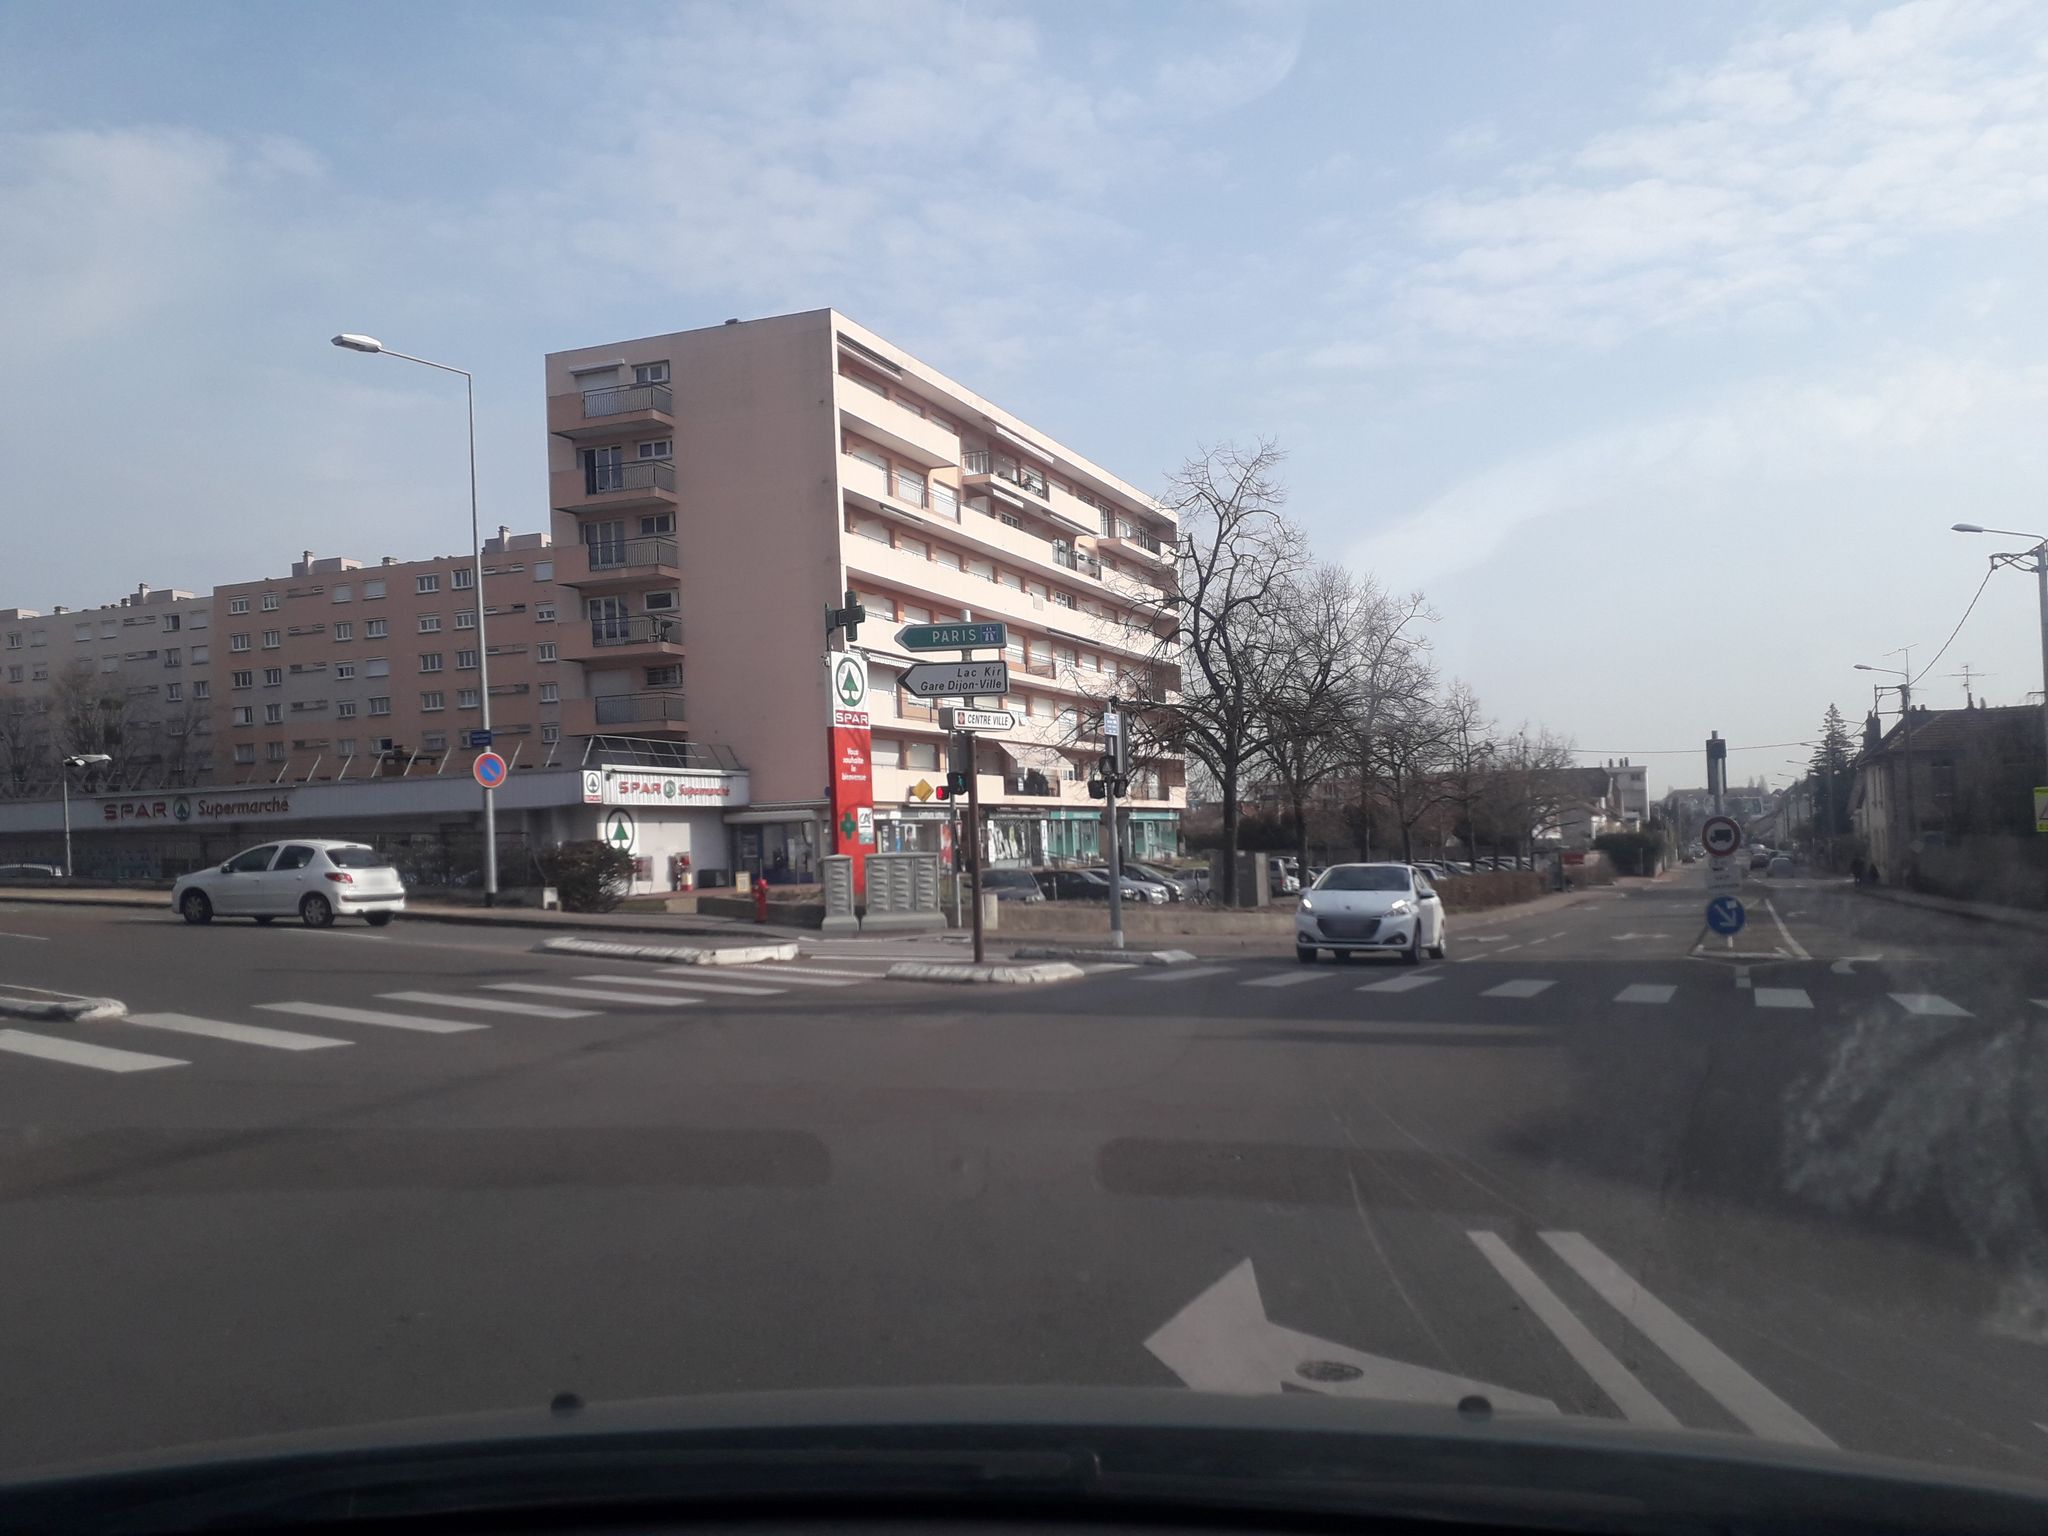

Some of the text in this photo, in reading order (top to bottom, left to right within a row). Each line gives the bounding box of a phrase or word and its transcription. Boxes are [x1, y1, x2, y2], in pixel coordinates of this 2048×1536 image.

[932, 629, 977, 643] PARIS
[957, 666, 1002, 678] Lac Kir
[920, 679, 1002, 692] Gare Dijon-Ville
[836, 712, 868, 725] SPAR
[967, 714, 1009, 726] CENTRE VILLE
[618, 781, 662, 795] SPAR
[103, 795, 289, 821] SPAR Supermarché
